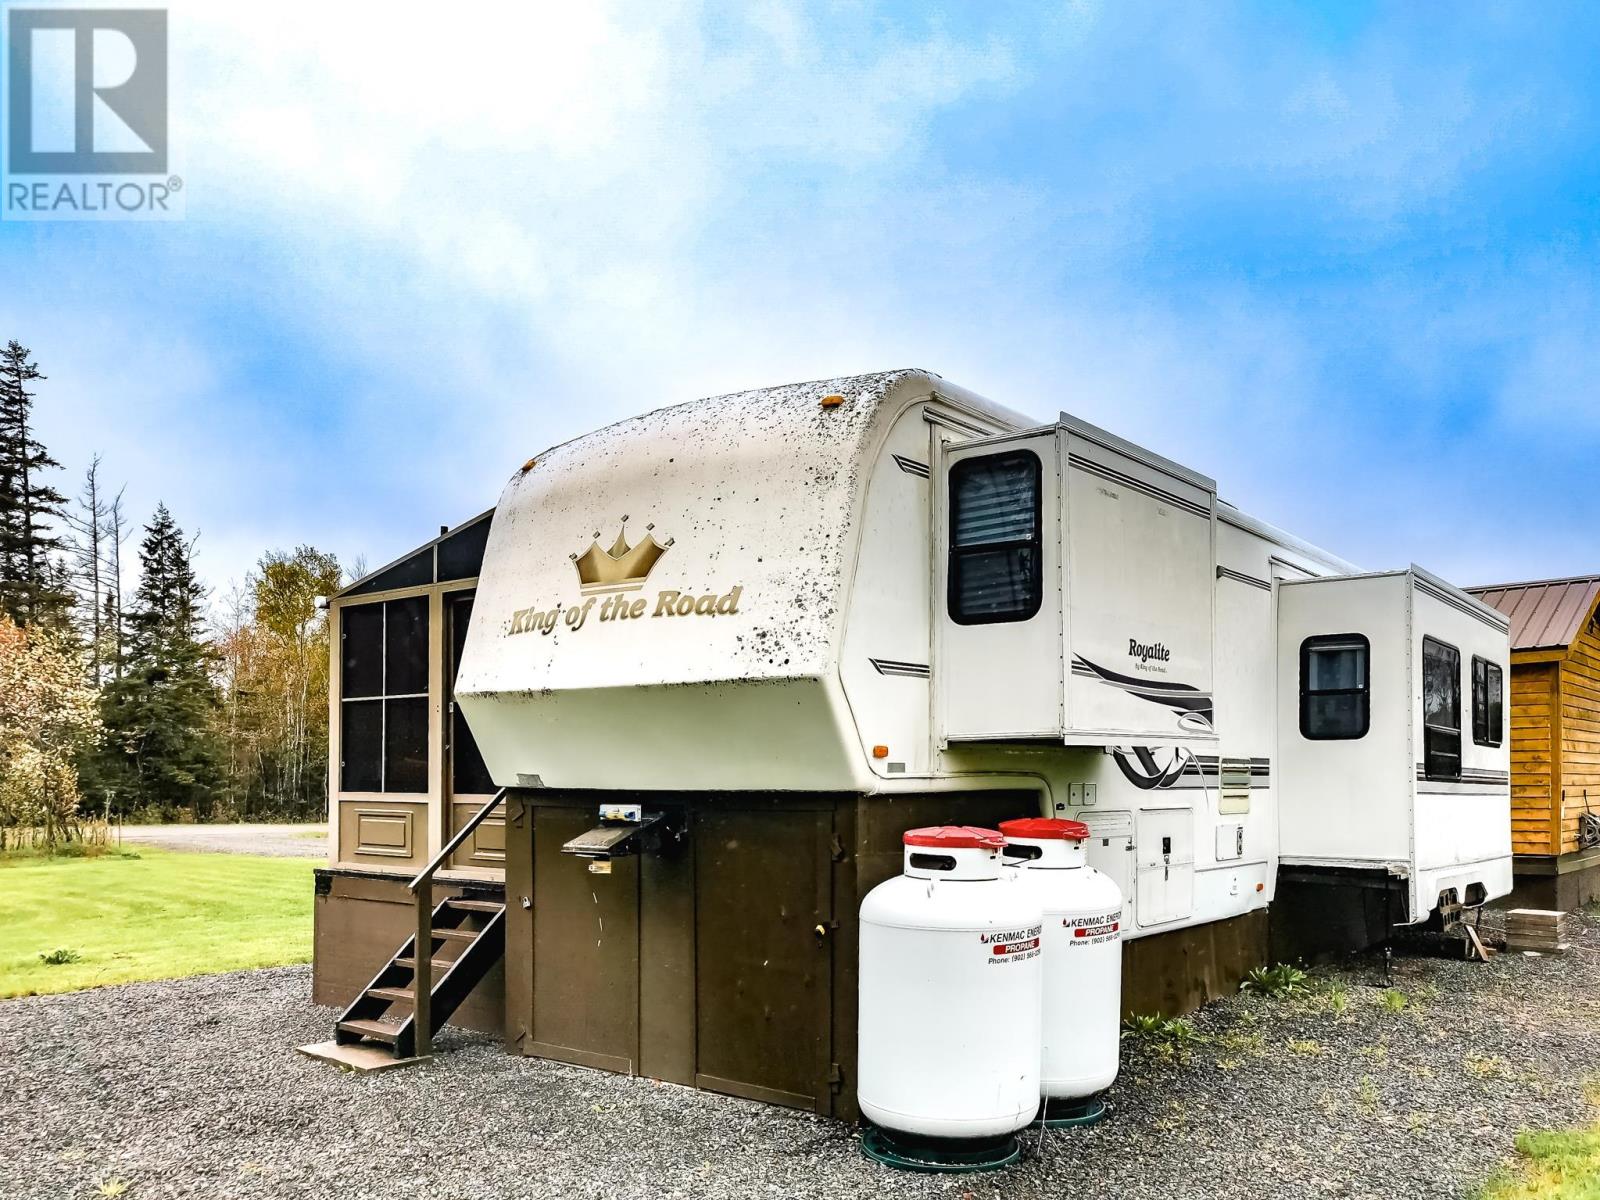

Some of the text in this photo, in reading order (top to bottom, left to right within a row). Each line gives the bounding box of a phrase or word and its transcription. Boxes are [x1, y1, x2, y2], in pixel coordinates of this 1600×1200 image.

[508, 585, 744, 636] King of the Road
[1128, 638, 1170, 662] Royalite
[1071, 915, 1105, 928] KENMAC
[989, 930, 1025, 943] KENMAC
[1085, 925, 1114, 936] PROPANE
[1005, 940, 1036, 953] PROPANE
[988, 957, 1010, 965] Phone:
